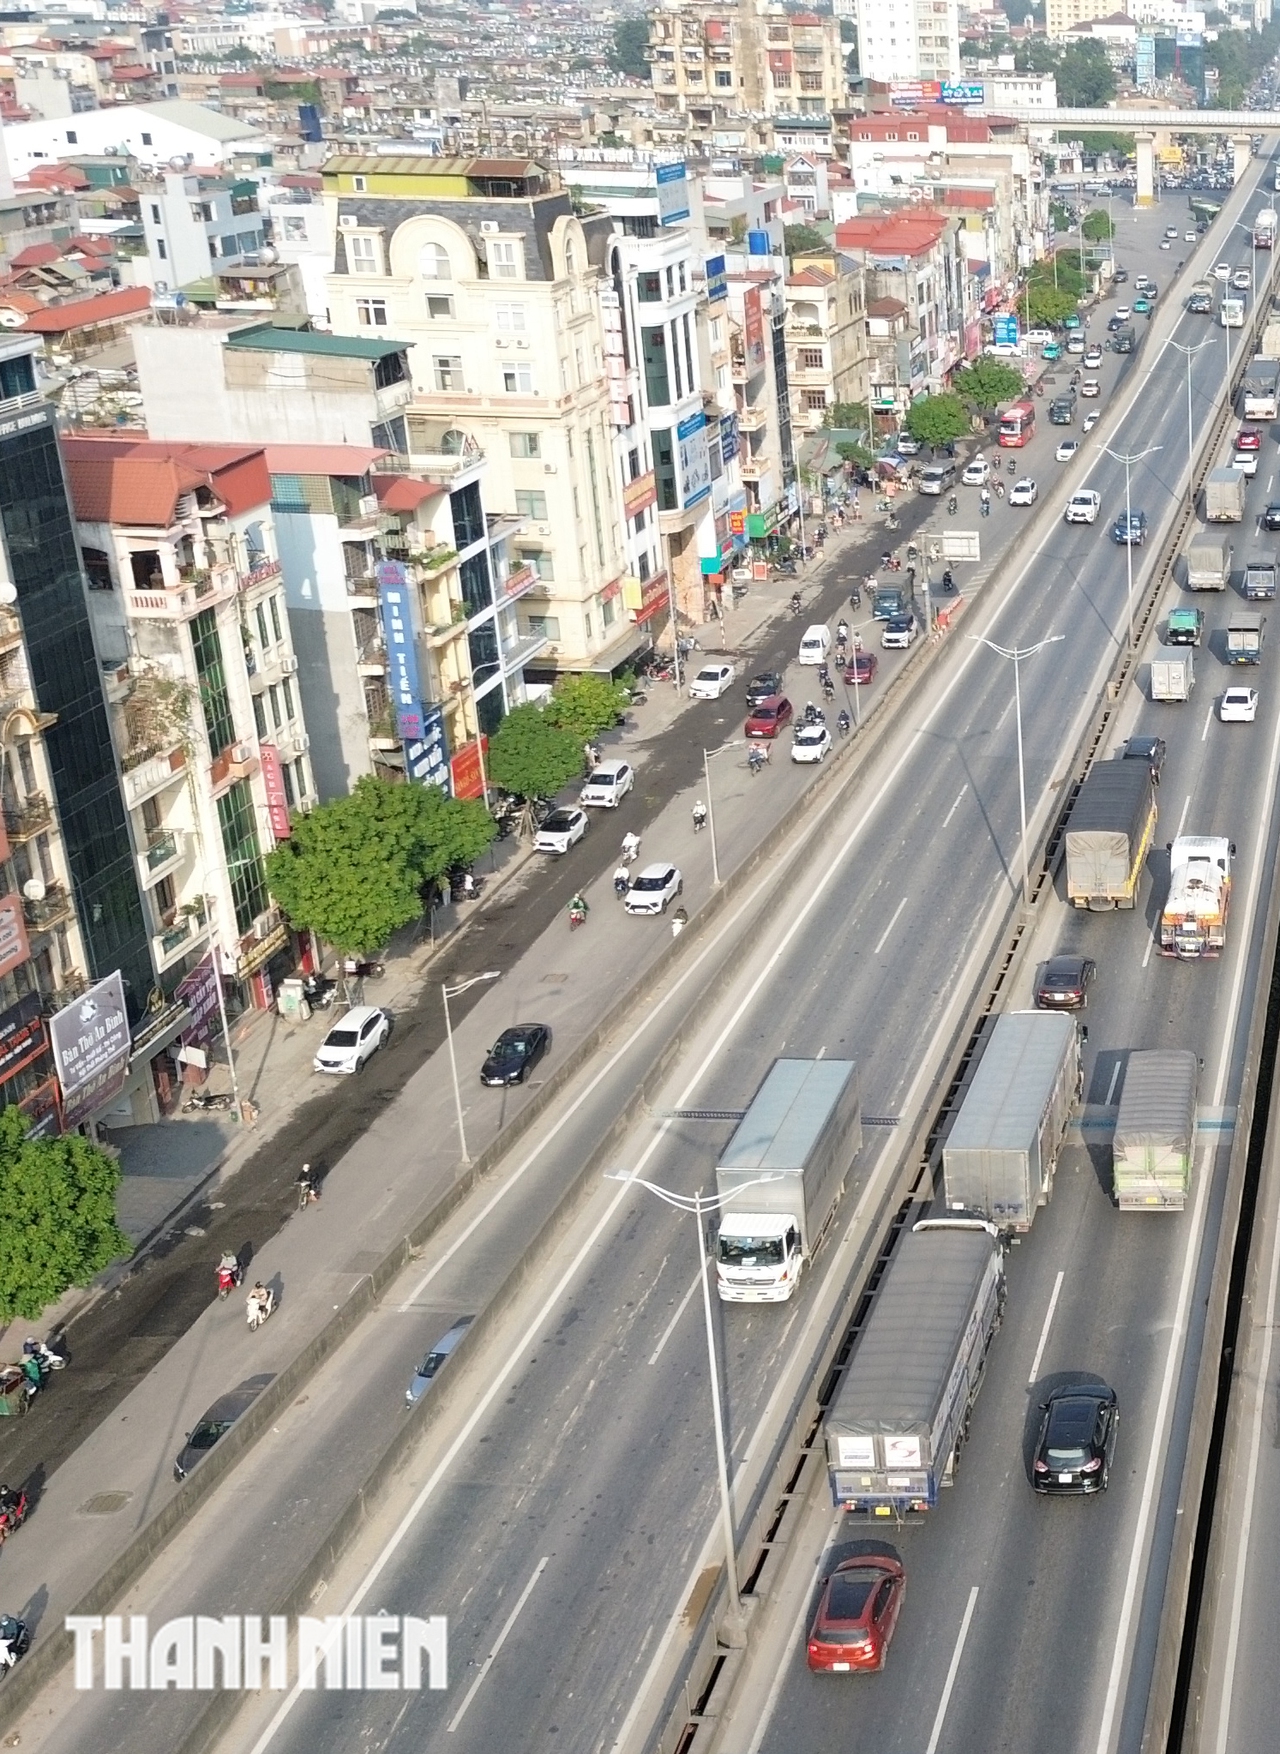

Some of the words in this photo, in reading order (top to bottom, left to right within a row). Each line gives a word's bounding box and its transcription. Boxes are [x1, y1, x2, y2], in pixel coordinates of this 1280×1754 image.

[61, 1044, 78, 1066] Bàn
[78, 1031, 95, 1052] Thờ
[95, 1026, 105, 1045] An
[105, 1011, 125, 1034] Bình
